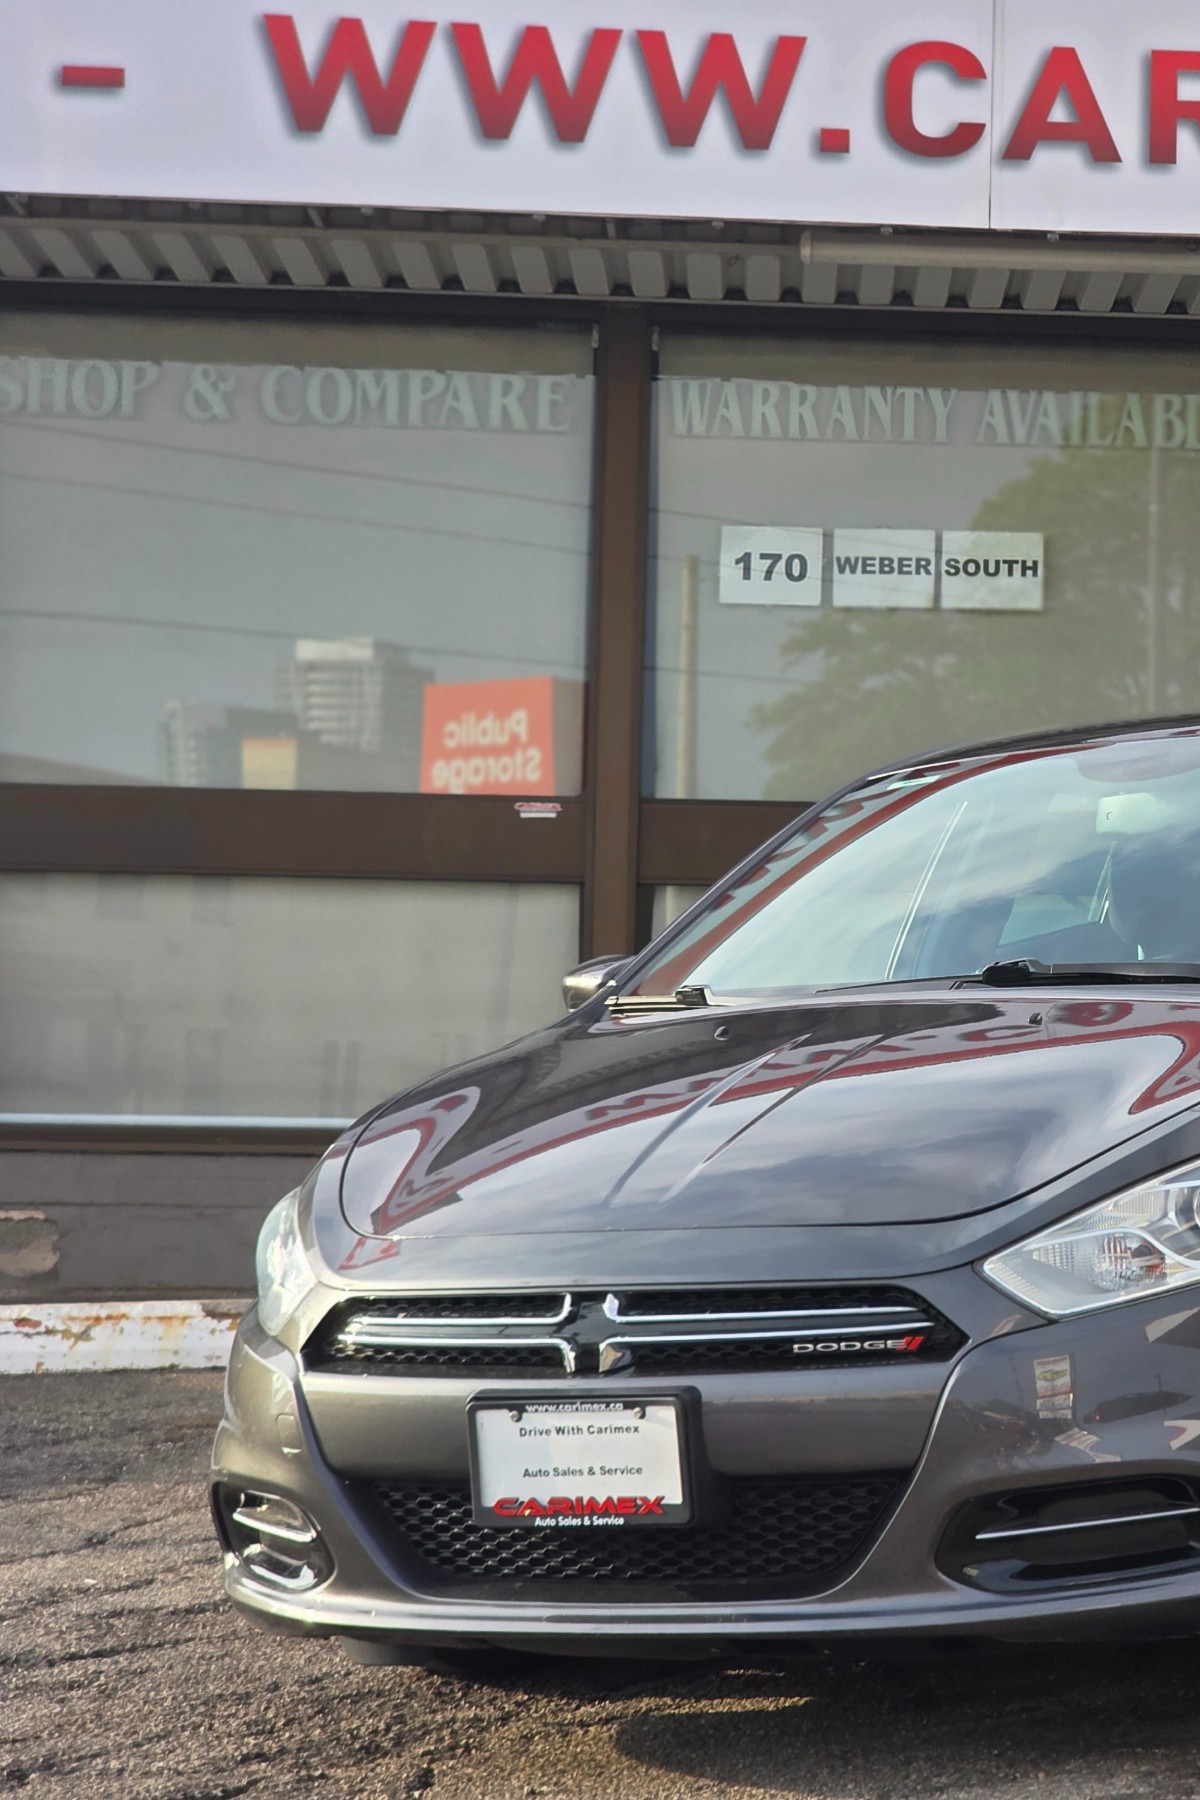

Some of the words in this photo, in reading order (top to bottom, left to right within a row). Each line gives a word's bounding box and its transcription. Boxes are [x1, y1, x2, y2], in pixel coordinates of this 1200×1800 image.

[183, 364, 236, 421] &
[260, 365, 572, 434] COMPARE
[670, 379, 957, 442] WARRANTY
[733, 551, 809, 583] 170
[835, 555, 932, 577] WEBER
[944, 558, 1039, 578] SOUTH
[793, 1339, 906, 1353] DODGE
[525, 1402, 623, 1412] www.carimex.ca
[519, 1427, 551, 1437] Drive
[554, 1425, 584, 1436] With
[587, 1424, 640, 1435] Carimex
[523, 1468, 550, 1478] Auto
[553, 1467, 584, 1477] Sales
[588, 1466, 596, 1476] &
[600, 1466, 643, 1476] Service
[492, 1496, 665, 1517] CARIMEX
[535, 1516, 555, 1527] Auto
[557, 1516, 583, 1527] Sales
[584, 1516, 591, 1526] &
[593, 1515, 625, 1526] Service
